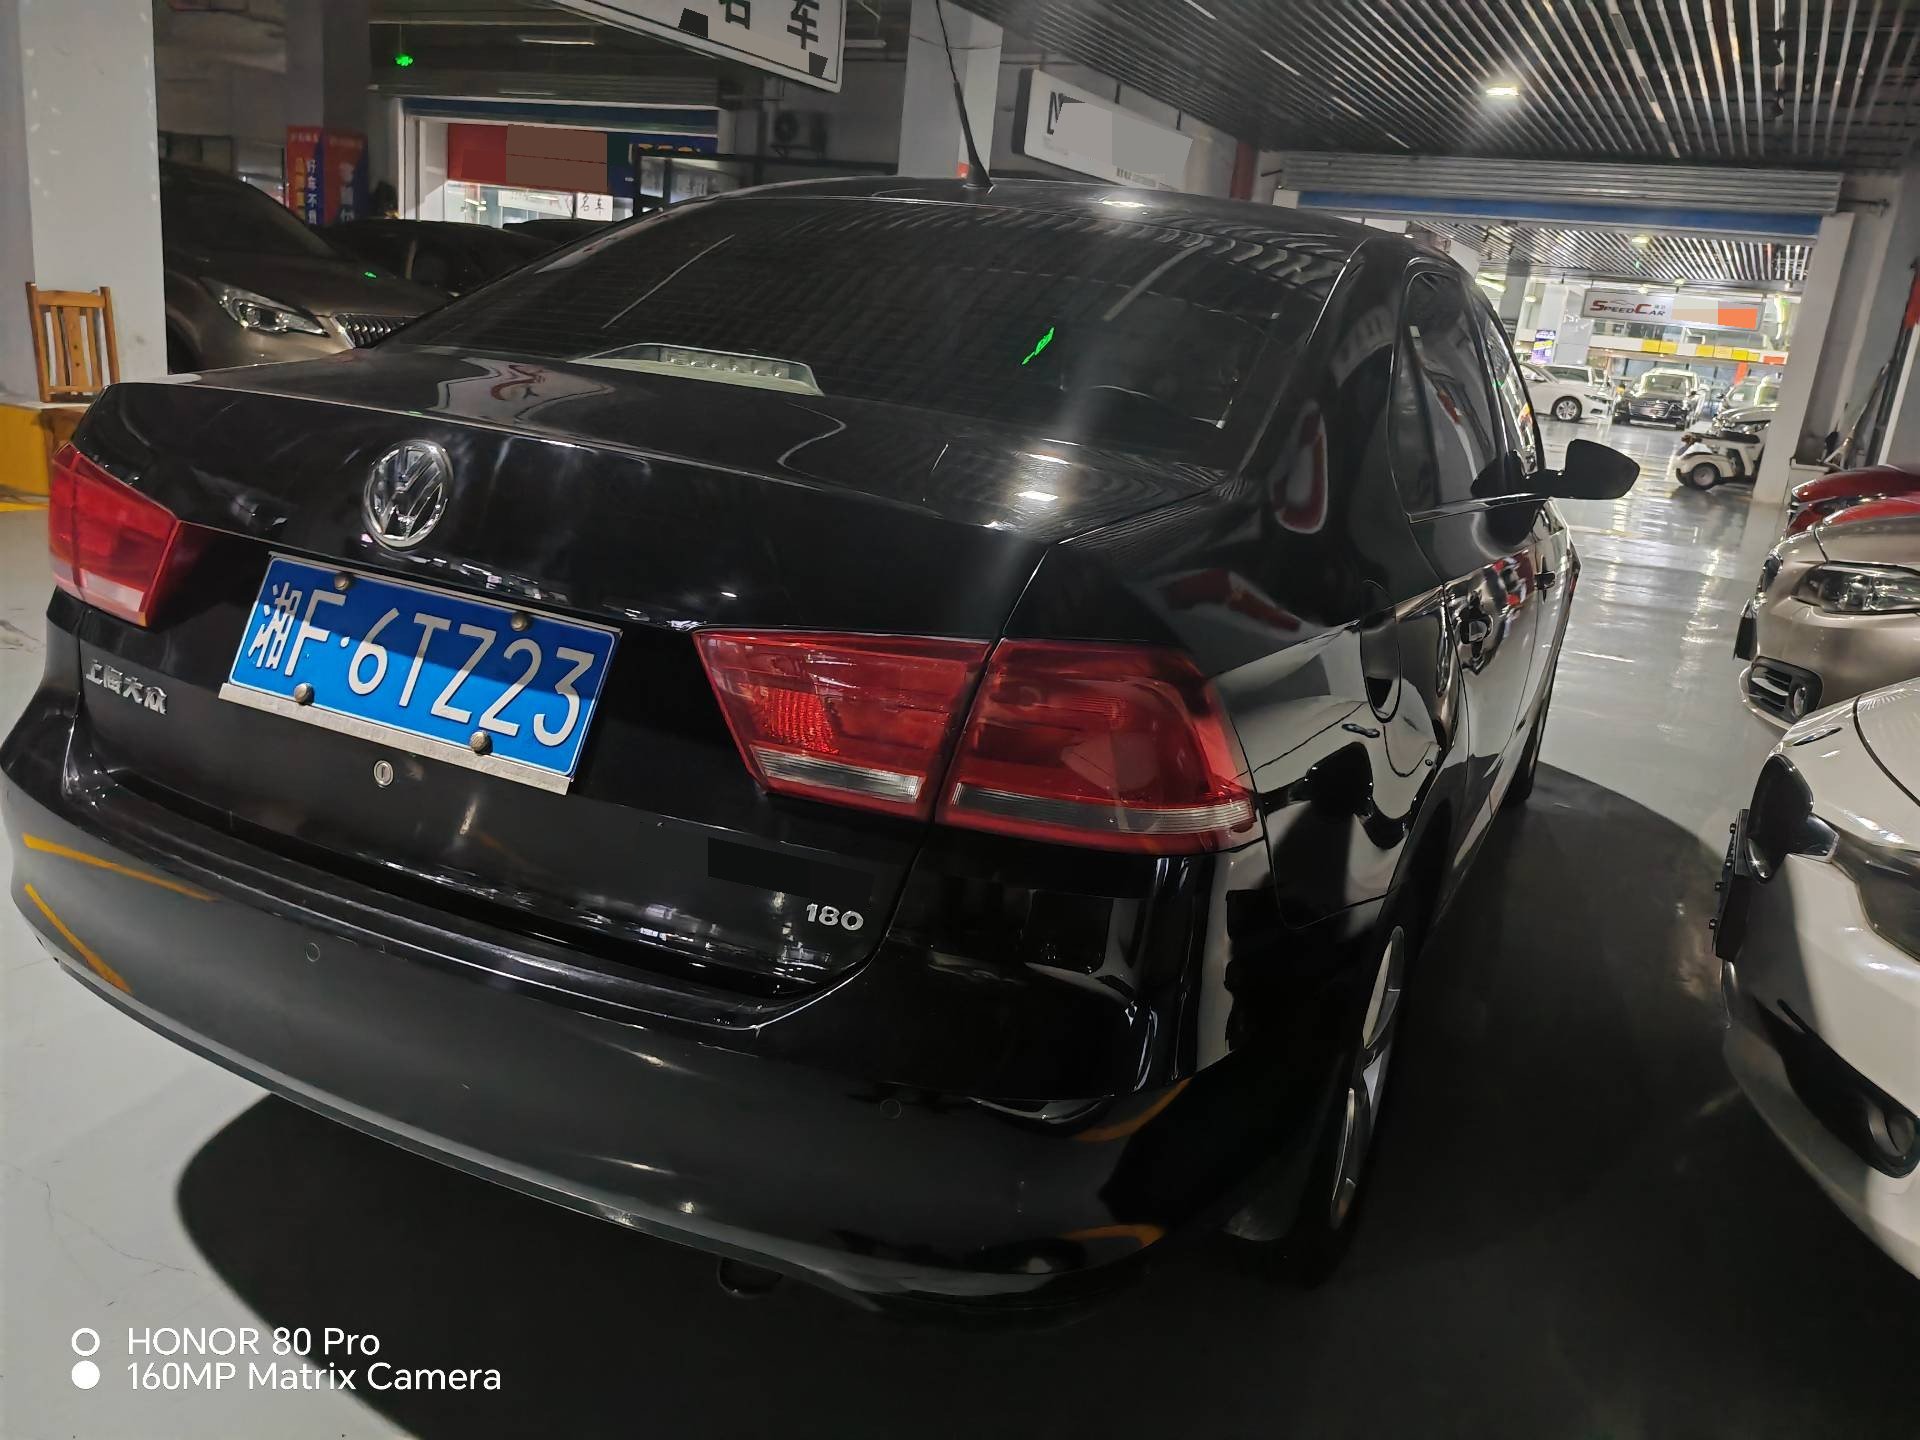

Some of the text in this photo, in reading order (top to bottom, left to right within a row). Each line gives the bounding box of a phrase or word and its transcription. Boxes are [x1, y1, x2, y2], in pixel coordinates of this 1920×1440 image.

[85, 659, 168, 716] 上海大众
[806, 903, 864, 931] 180
